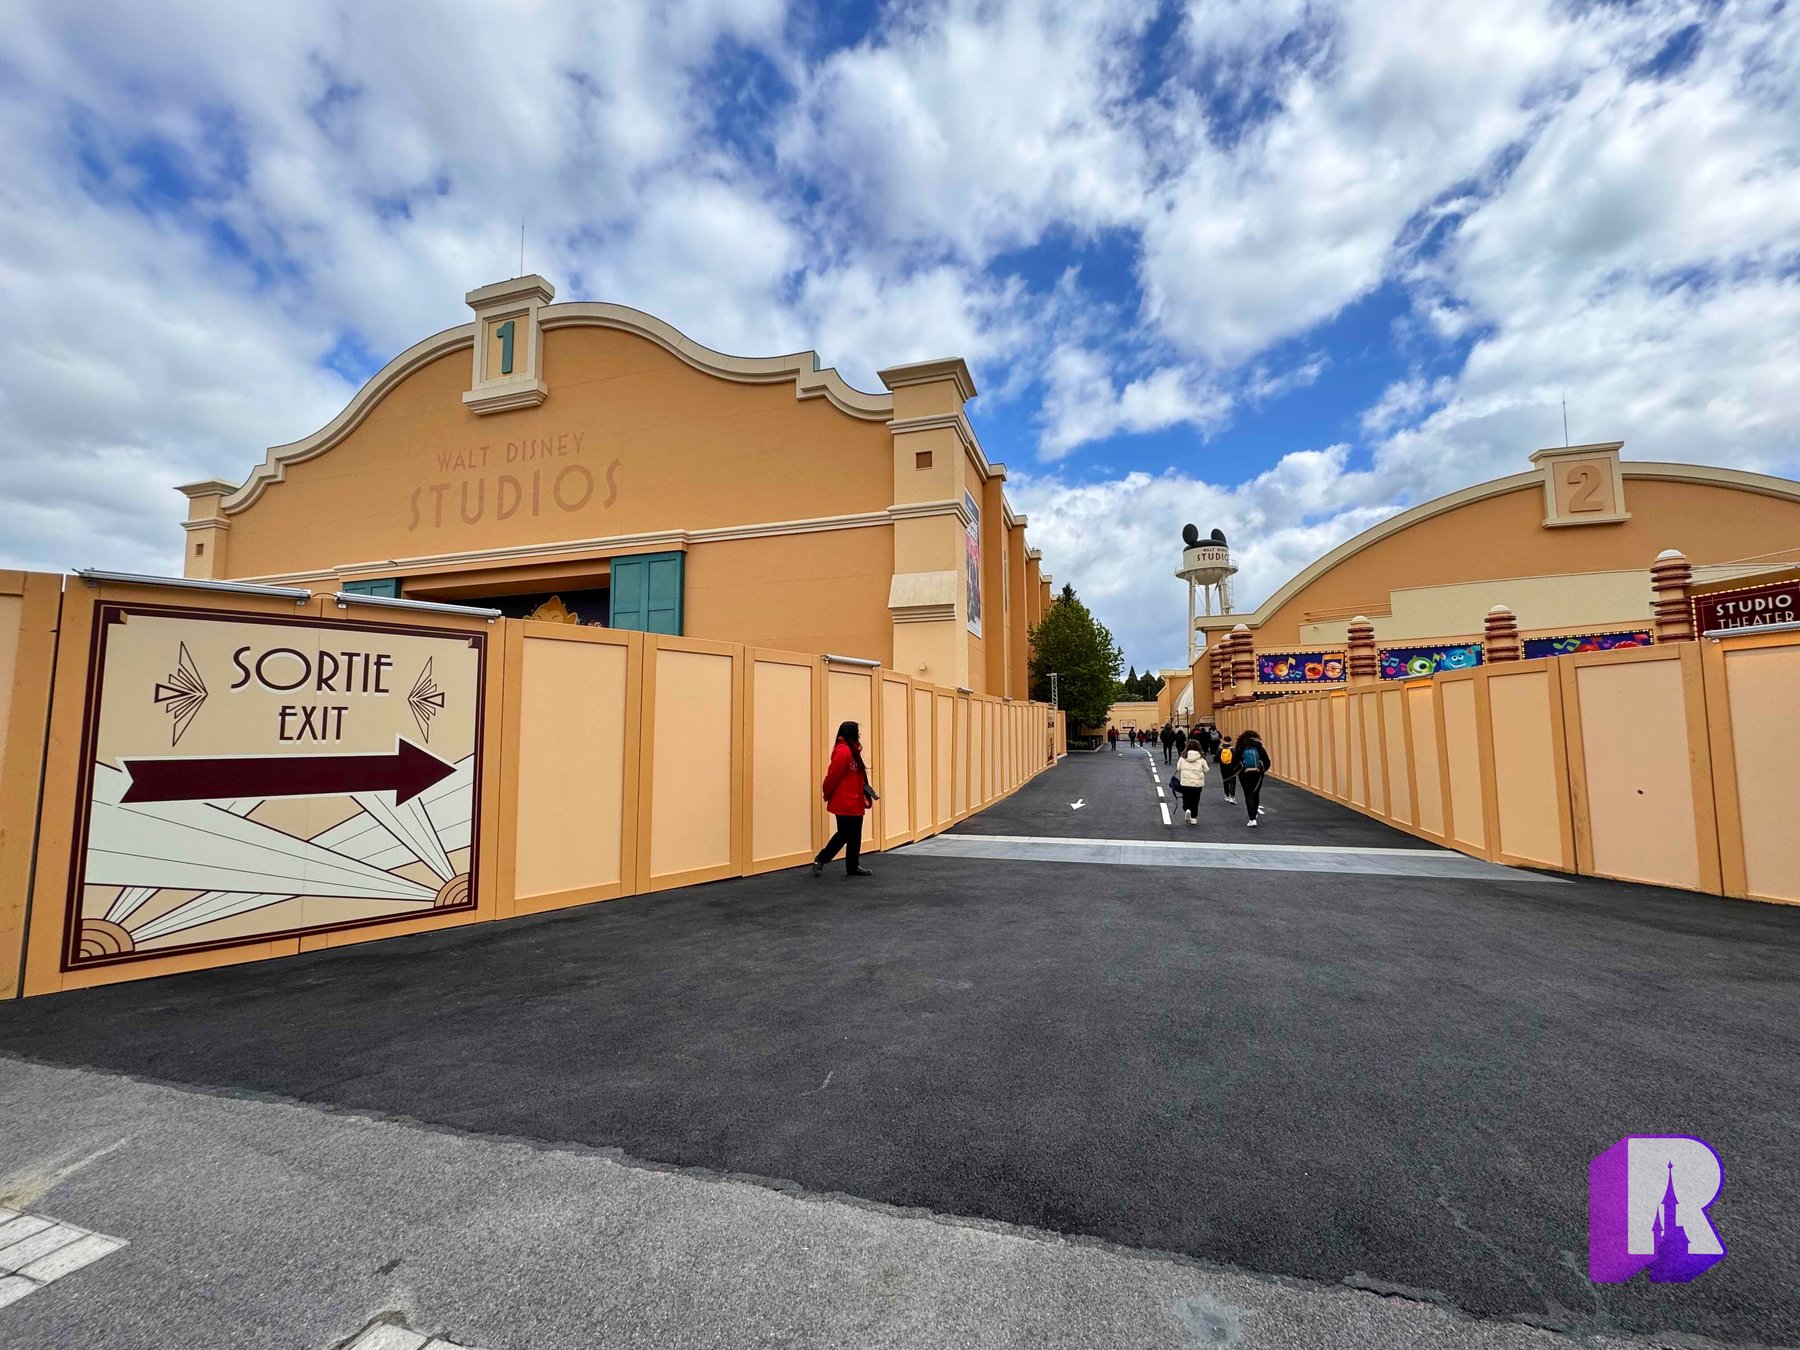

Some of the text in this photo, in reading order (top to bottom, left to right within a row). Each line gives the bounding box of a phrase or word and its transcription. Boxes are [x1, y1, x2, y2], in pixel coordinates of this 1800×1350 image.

[496, 319, 515, 375] 1
[437, 431, 585, 473] WALT DISNEY
[408, 458, 621, 533] STUDIOS
[1566, 464, 1604, 513] 2
[1197, 552, 1229, 562] STUDIO
[1716, 594, 1793, 617] STUDIO
[230, 645, 393, 694] SORTIE
[279, 705, 349, 742] EXIT
